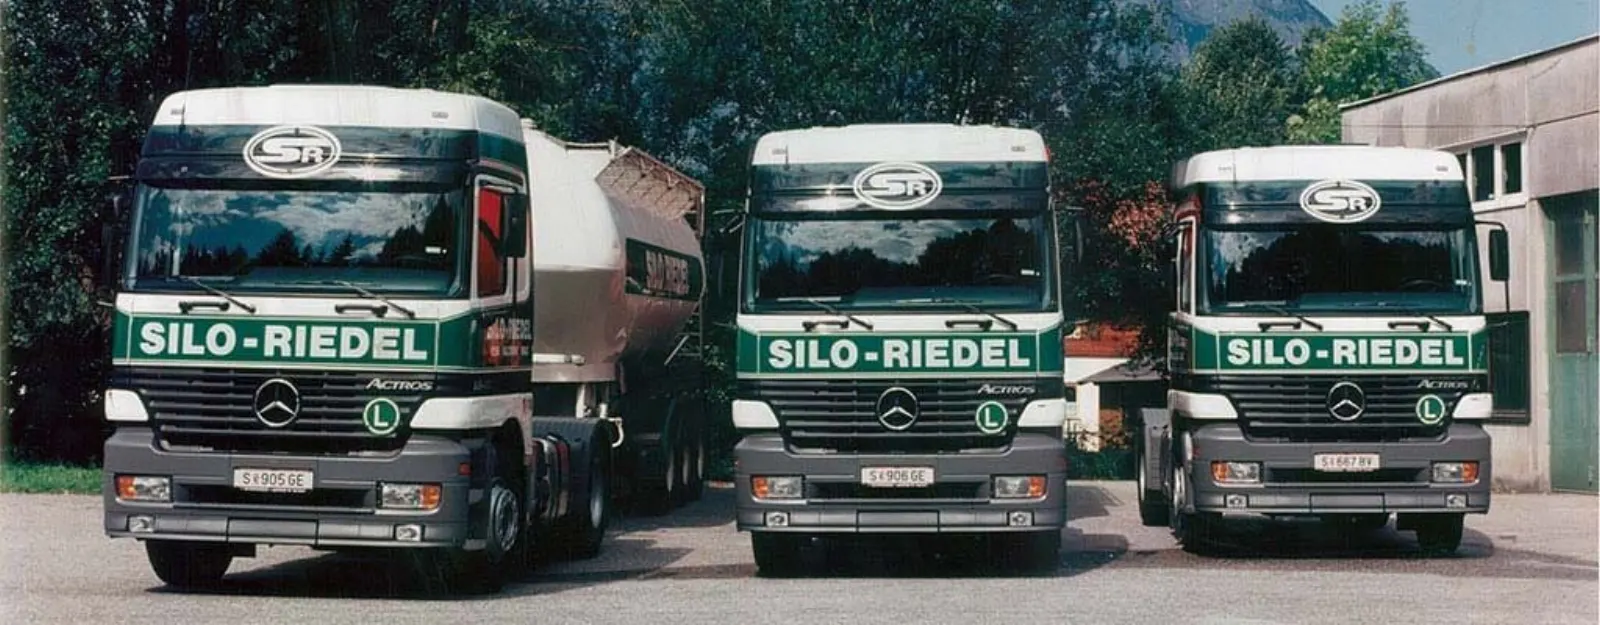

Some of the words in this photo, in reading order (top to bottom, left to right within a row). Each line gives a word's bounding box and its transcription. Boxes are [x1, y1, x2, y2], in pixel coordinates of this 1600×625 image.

[373, 404, 389, 428] L
[984, 406, 999, 428] L
[1423, 400, 1437, 419] L
